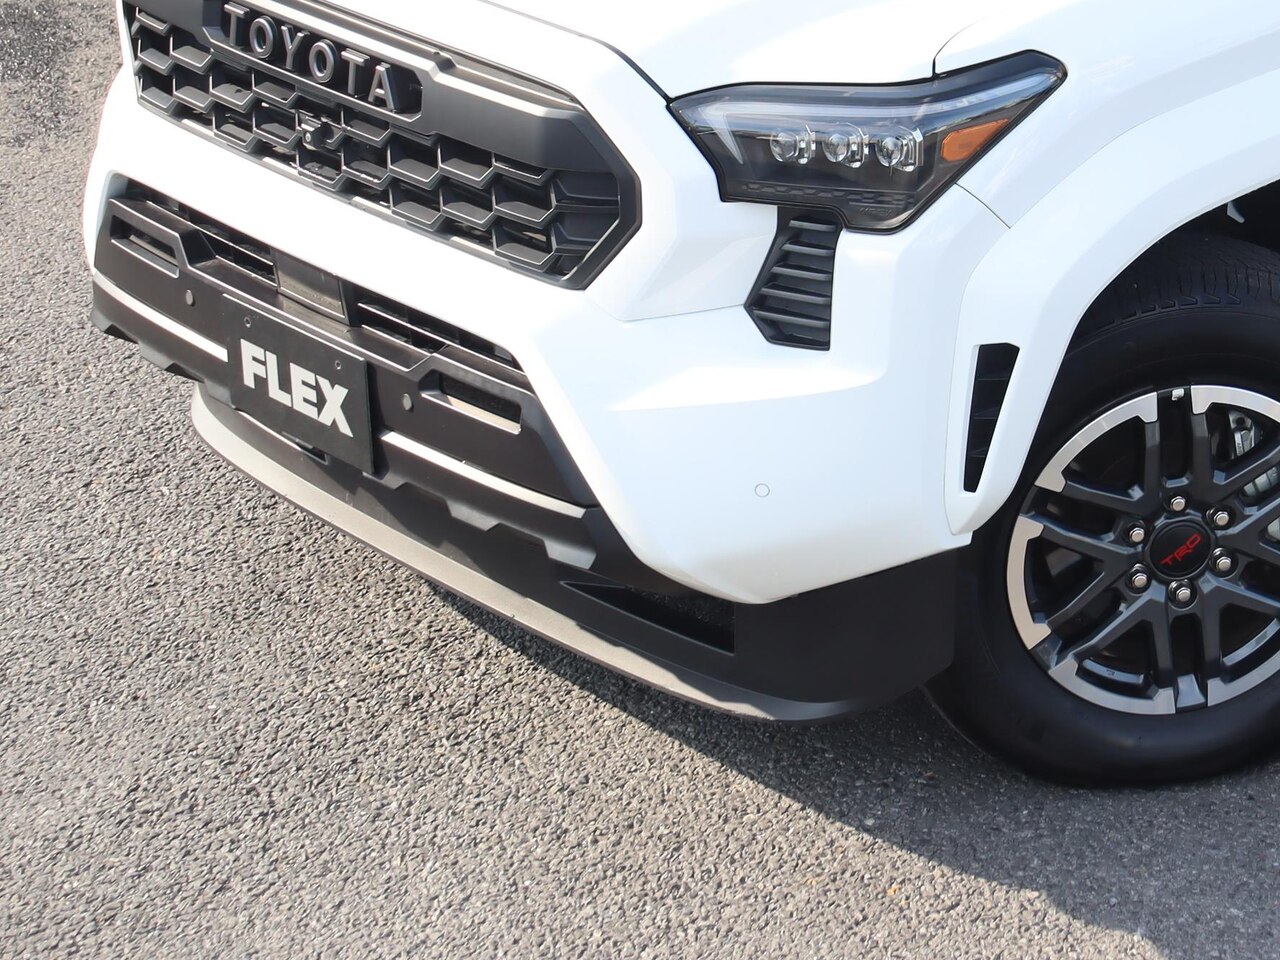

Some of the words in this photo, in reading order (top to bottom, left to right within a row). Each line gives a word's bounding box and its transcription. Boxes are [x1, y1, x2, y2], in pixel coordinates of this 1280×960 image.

[224, 2, 396, 112] TOYOTA
[240, 338, 354, 438] FLEX
[1160, 533, 1201, 566] TRD
